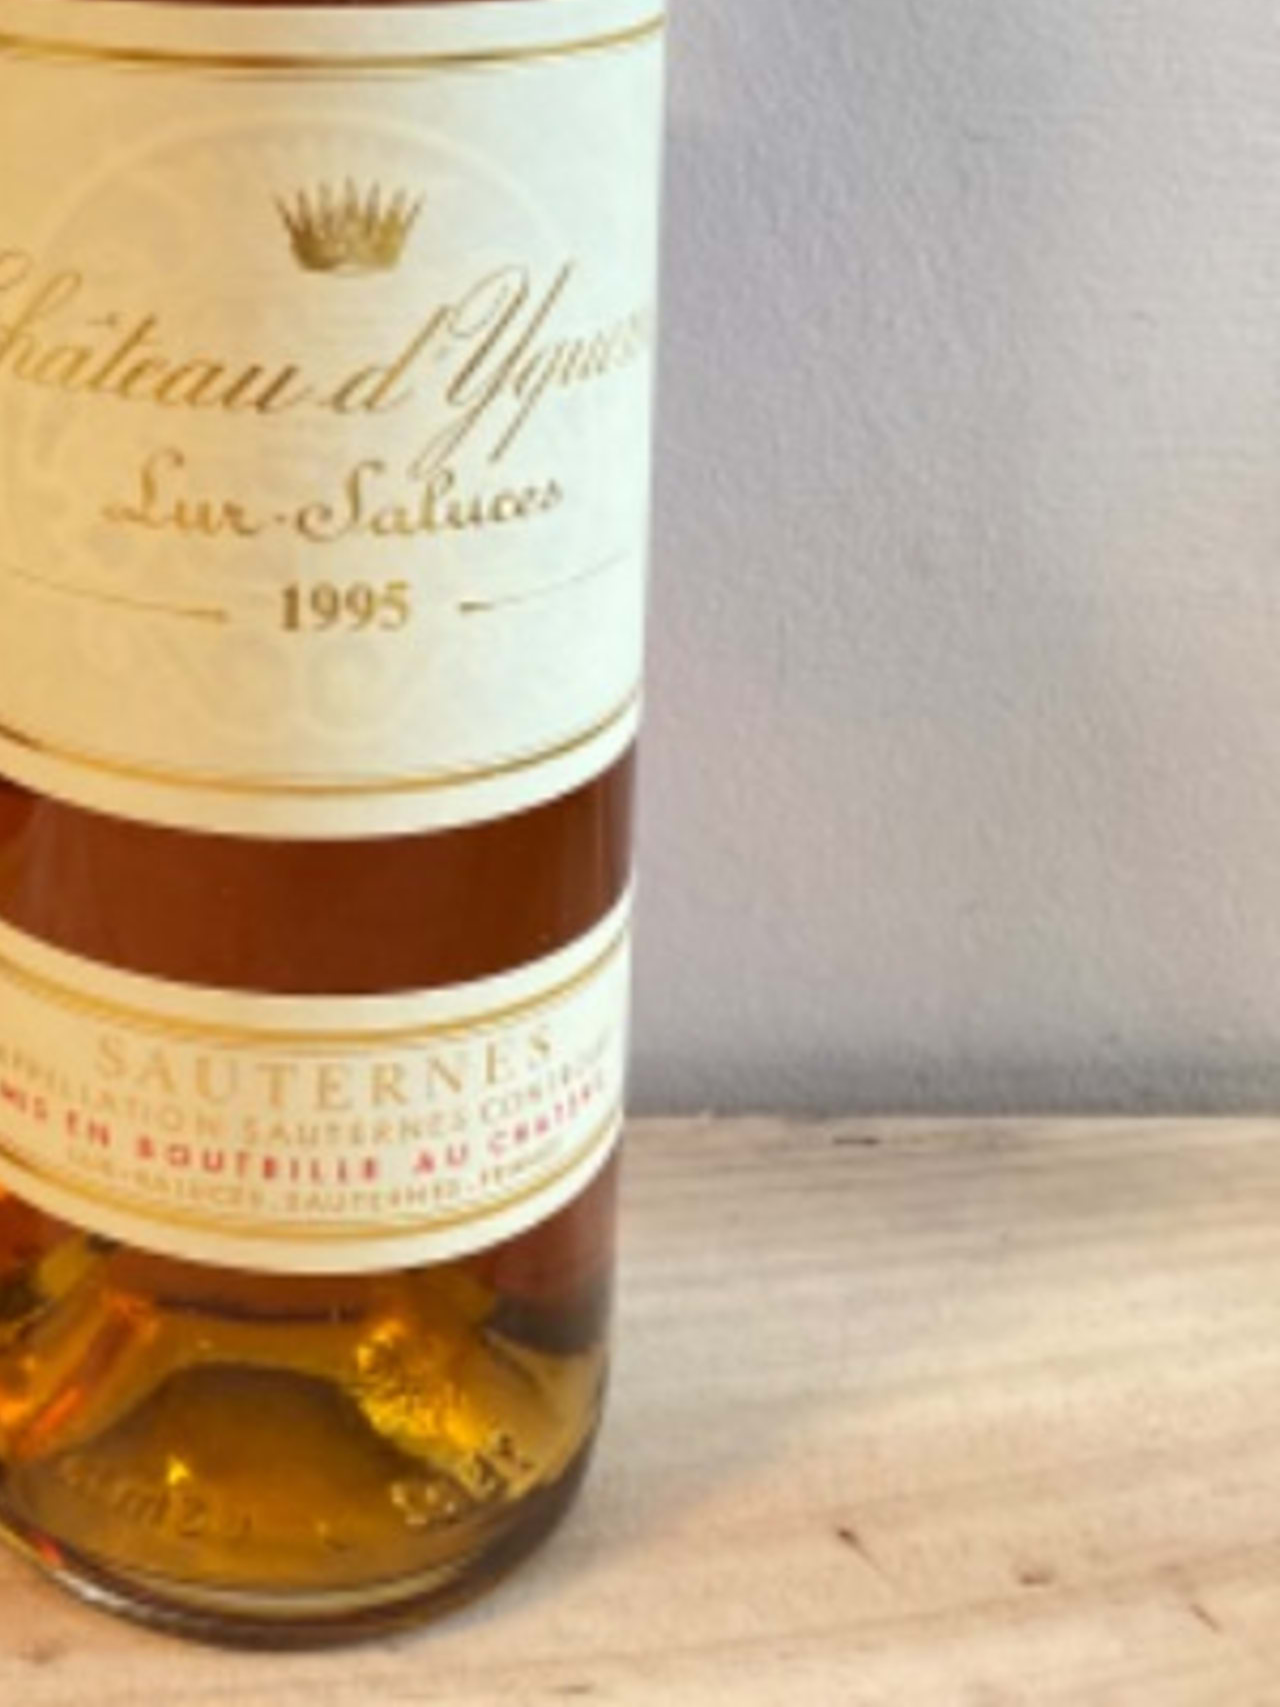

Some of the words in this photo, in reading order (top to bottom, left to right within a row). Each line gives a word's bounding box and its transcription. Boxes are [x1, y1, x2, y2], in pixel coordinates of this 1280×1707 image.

[281, 581, 412, 633] 1995
[96, 1024, 553, 1112] SAUTERNES
[63, 1107, 113, 1150] EN
[412, 1142, 470, 1176] AU
